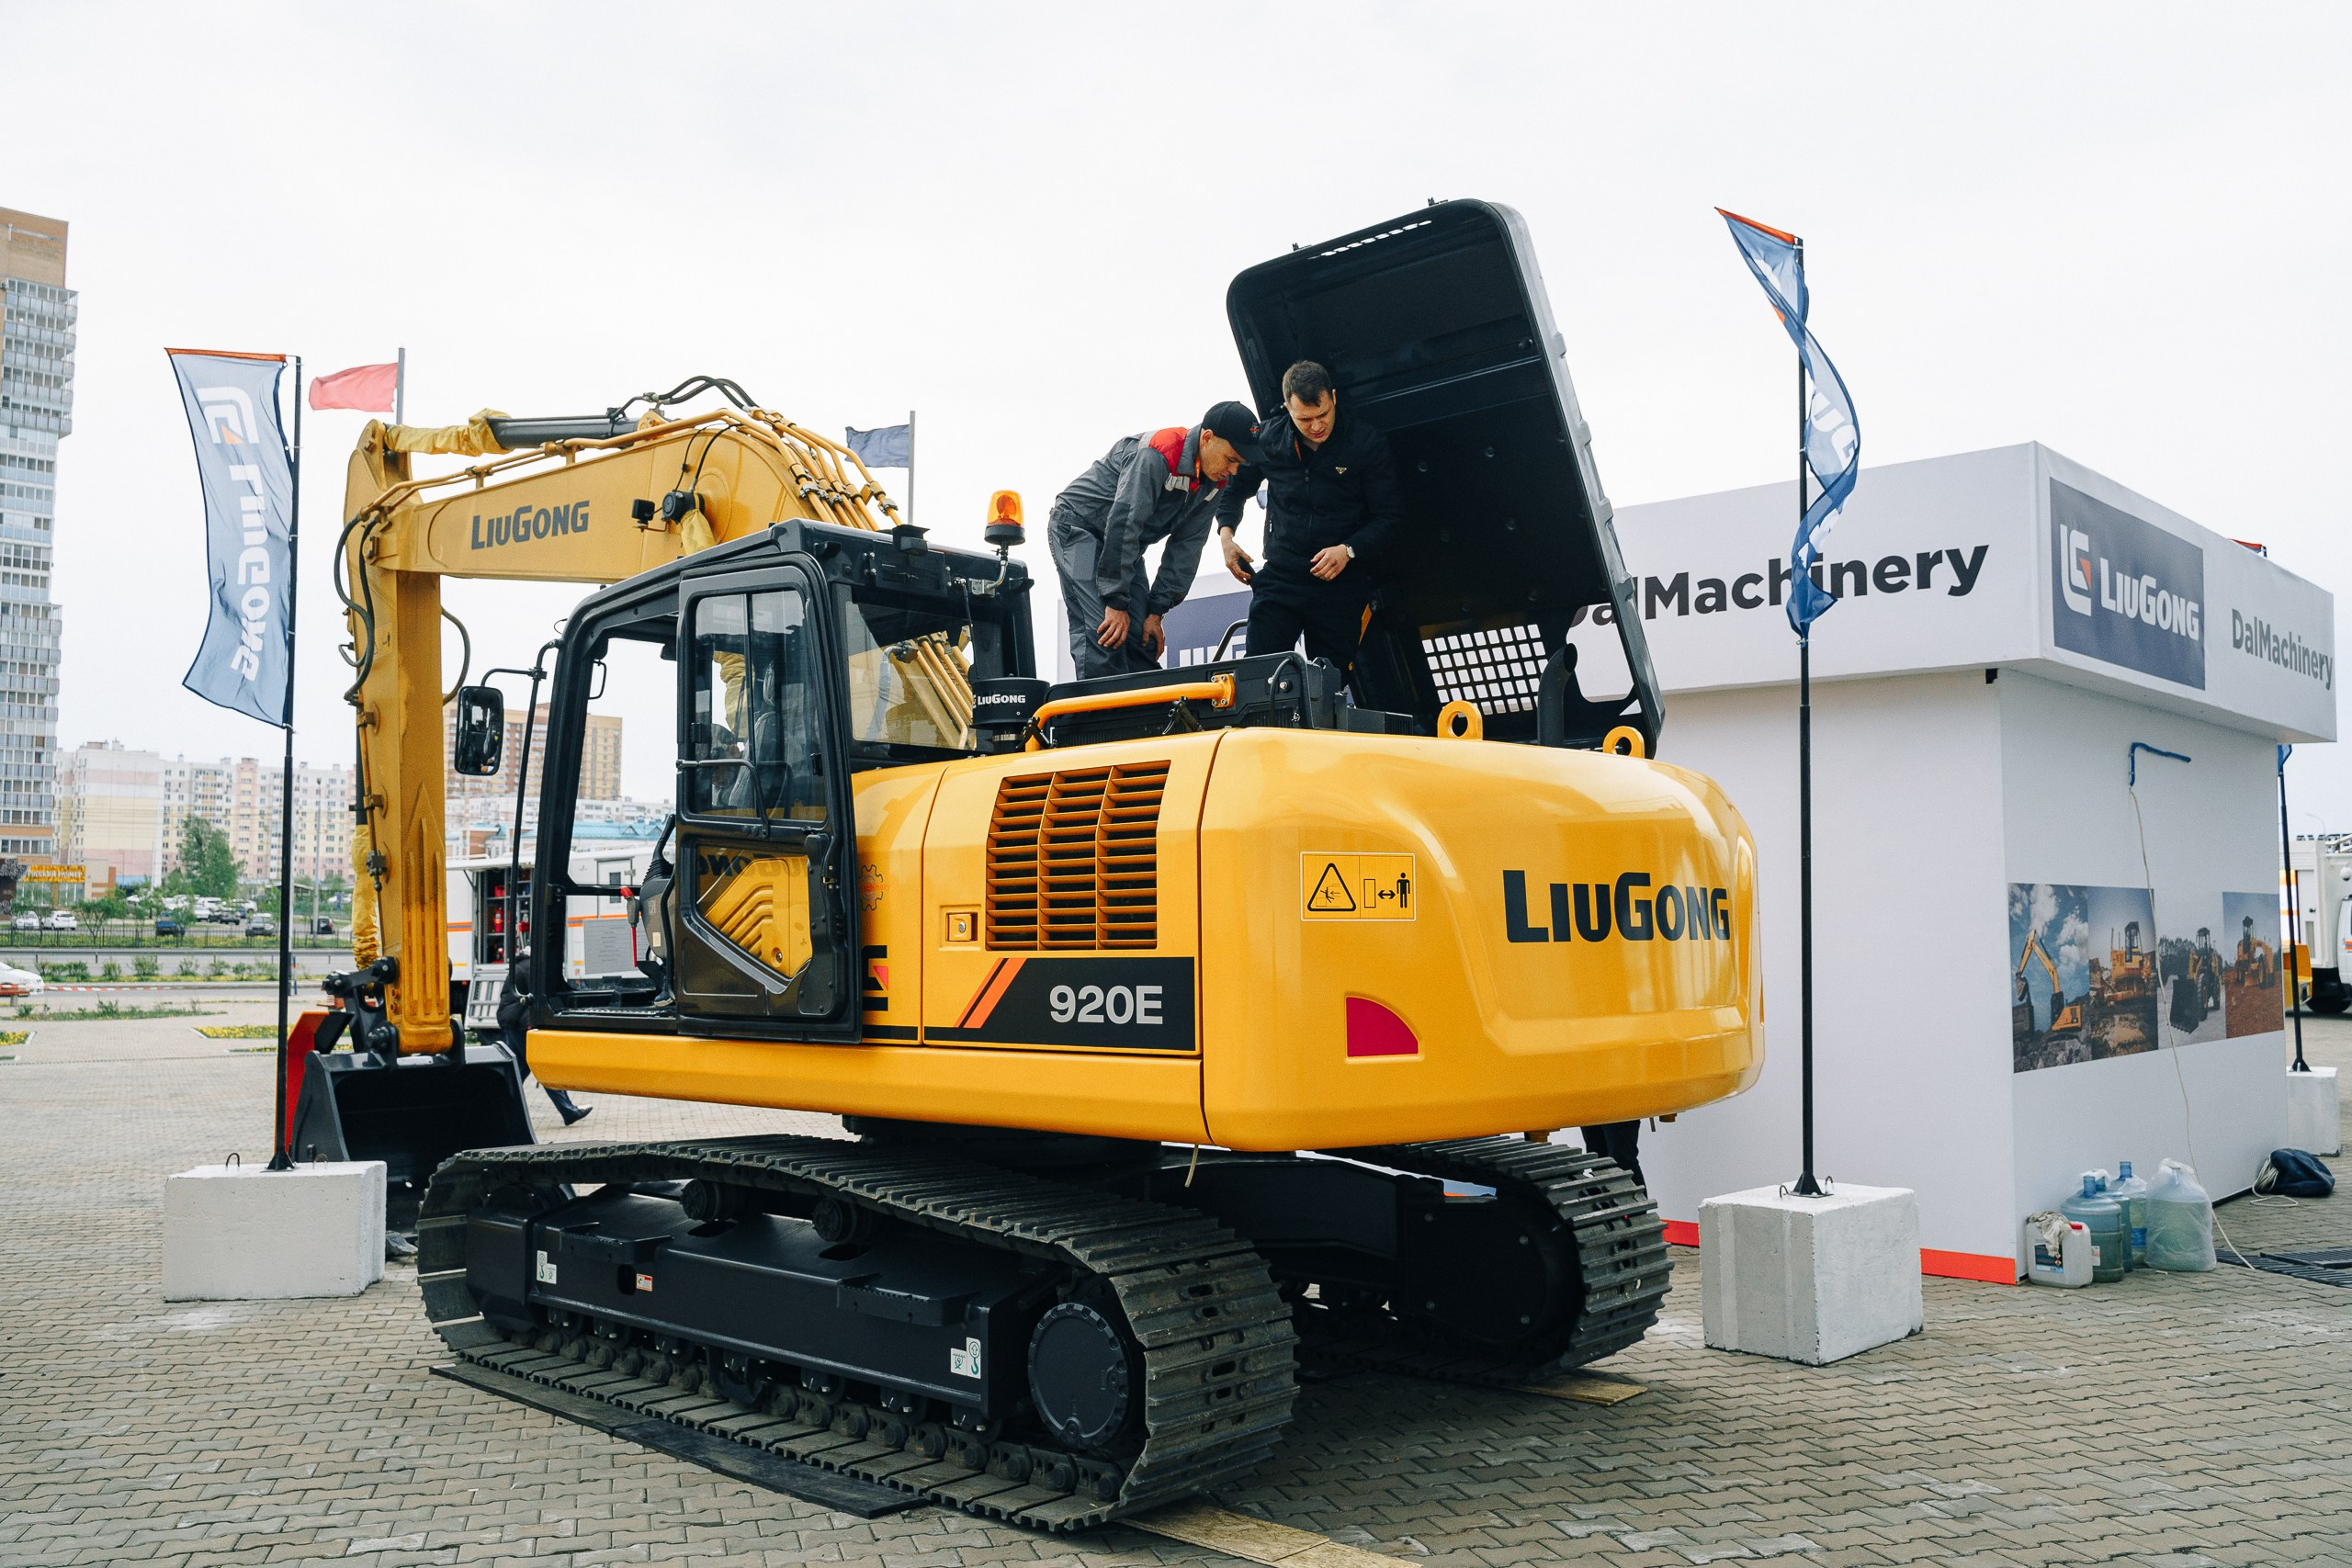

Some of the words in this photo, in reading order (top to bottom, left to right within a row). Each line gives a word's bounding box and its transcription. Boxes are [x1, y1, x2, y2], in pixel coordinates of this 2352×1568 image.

[471, 500, 590, 550] LIUGONG
[1570, 544, 1990, 628] aMachinery
[2099, 558, 2199, 641] LIUGONG
[2232, 608, 2333, 691] DalMachinery
[978, 694, 1025, 705] LIUGONG
[1502, 870, 1731, 942] LIUGONG
[1049, 985, 1163, 1025] 920E
